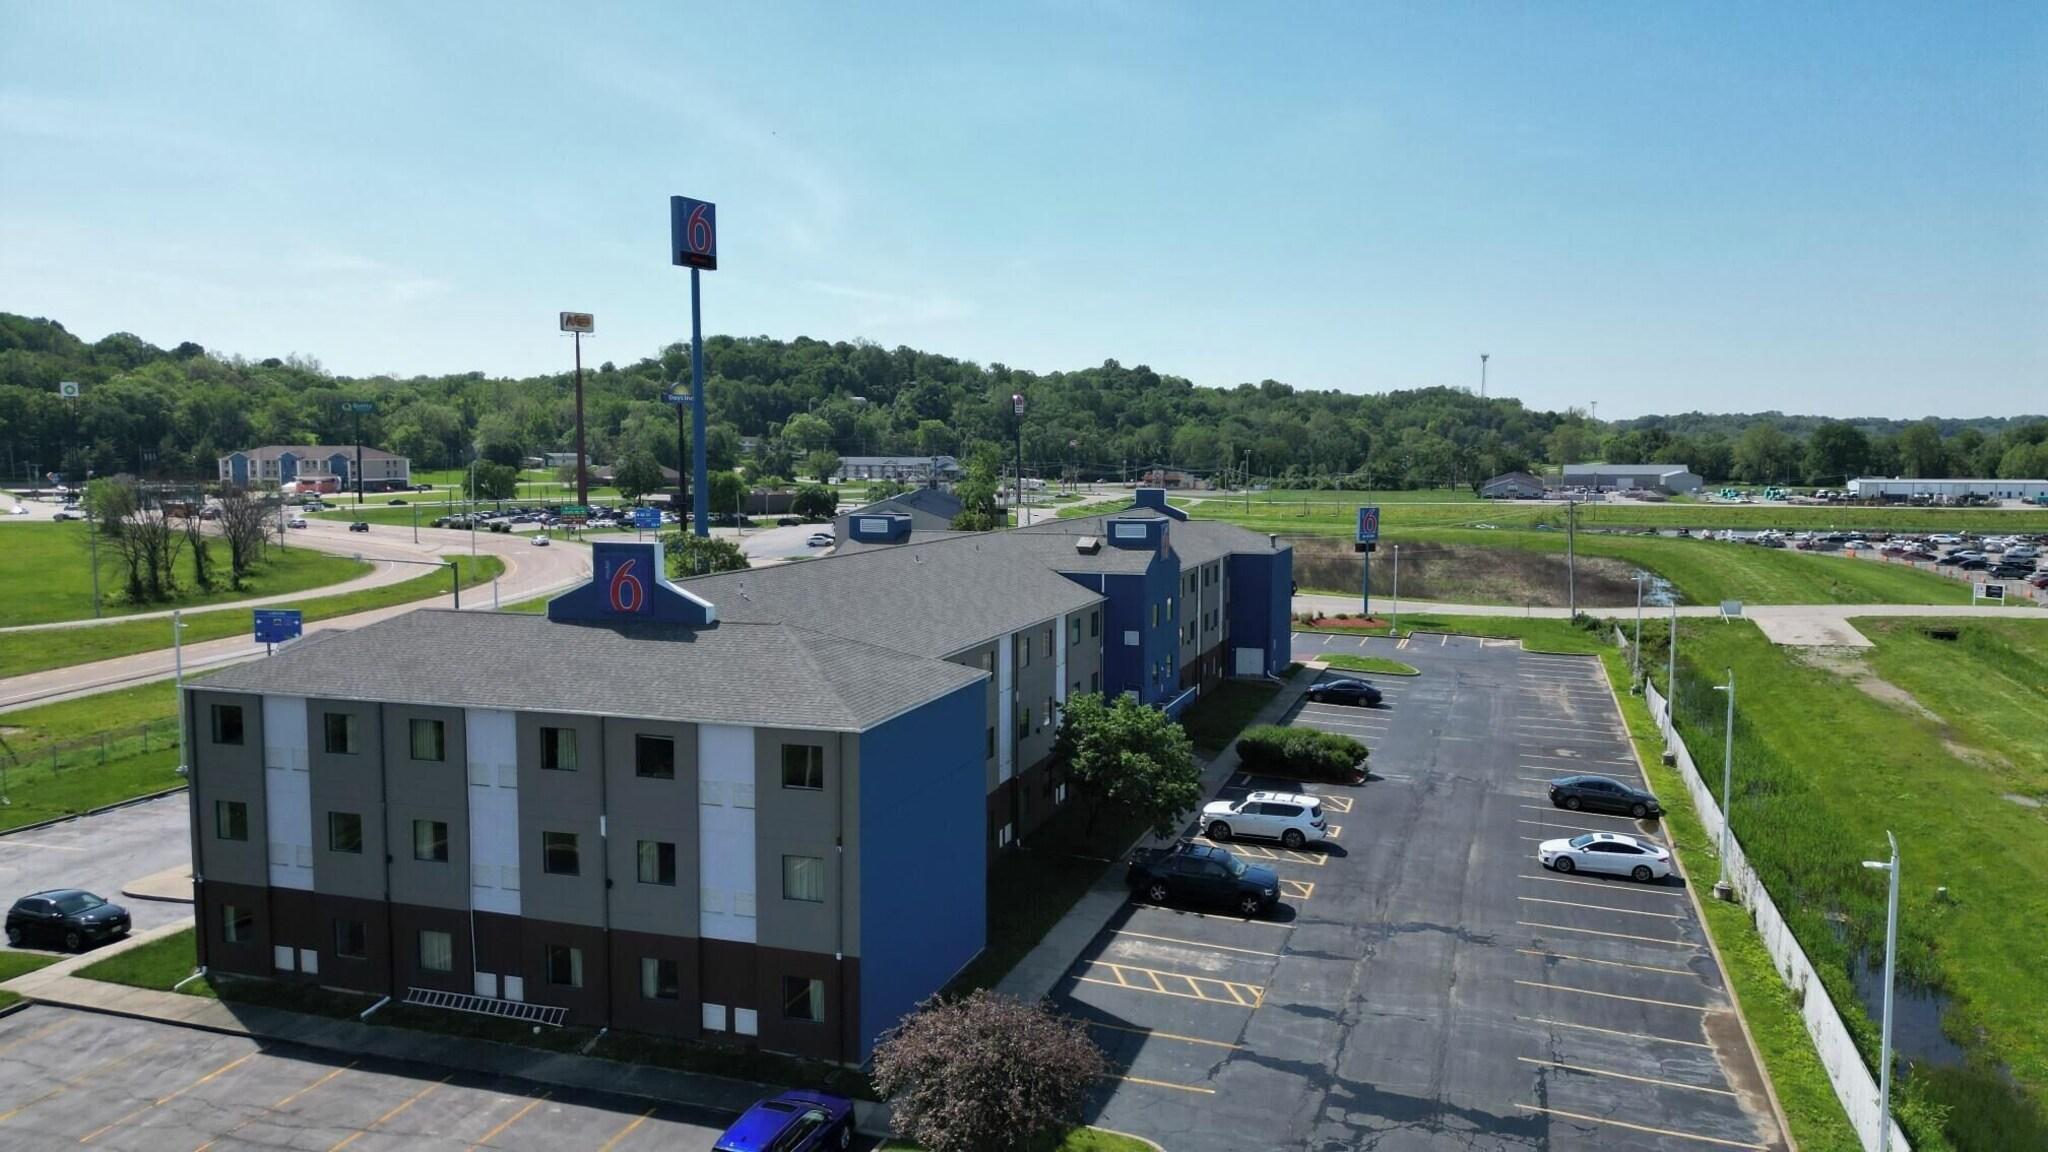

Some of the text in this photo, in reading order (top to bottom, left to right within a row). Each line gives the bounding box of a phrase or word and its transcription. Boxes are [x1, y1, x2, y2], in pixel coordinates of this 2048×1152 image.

[687, 203, 713, 255] 6
[1363, 511, 1377, 533] 6
[610, 558, 643, 613] 6
